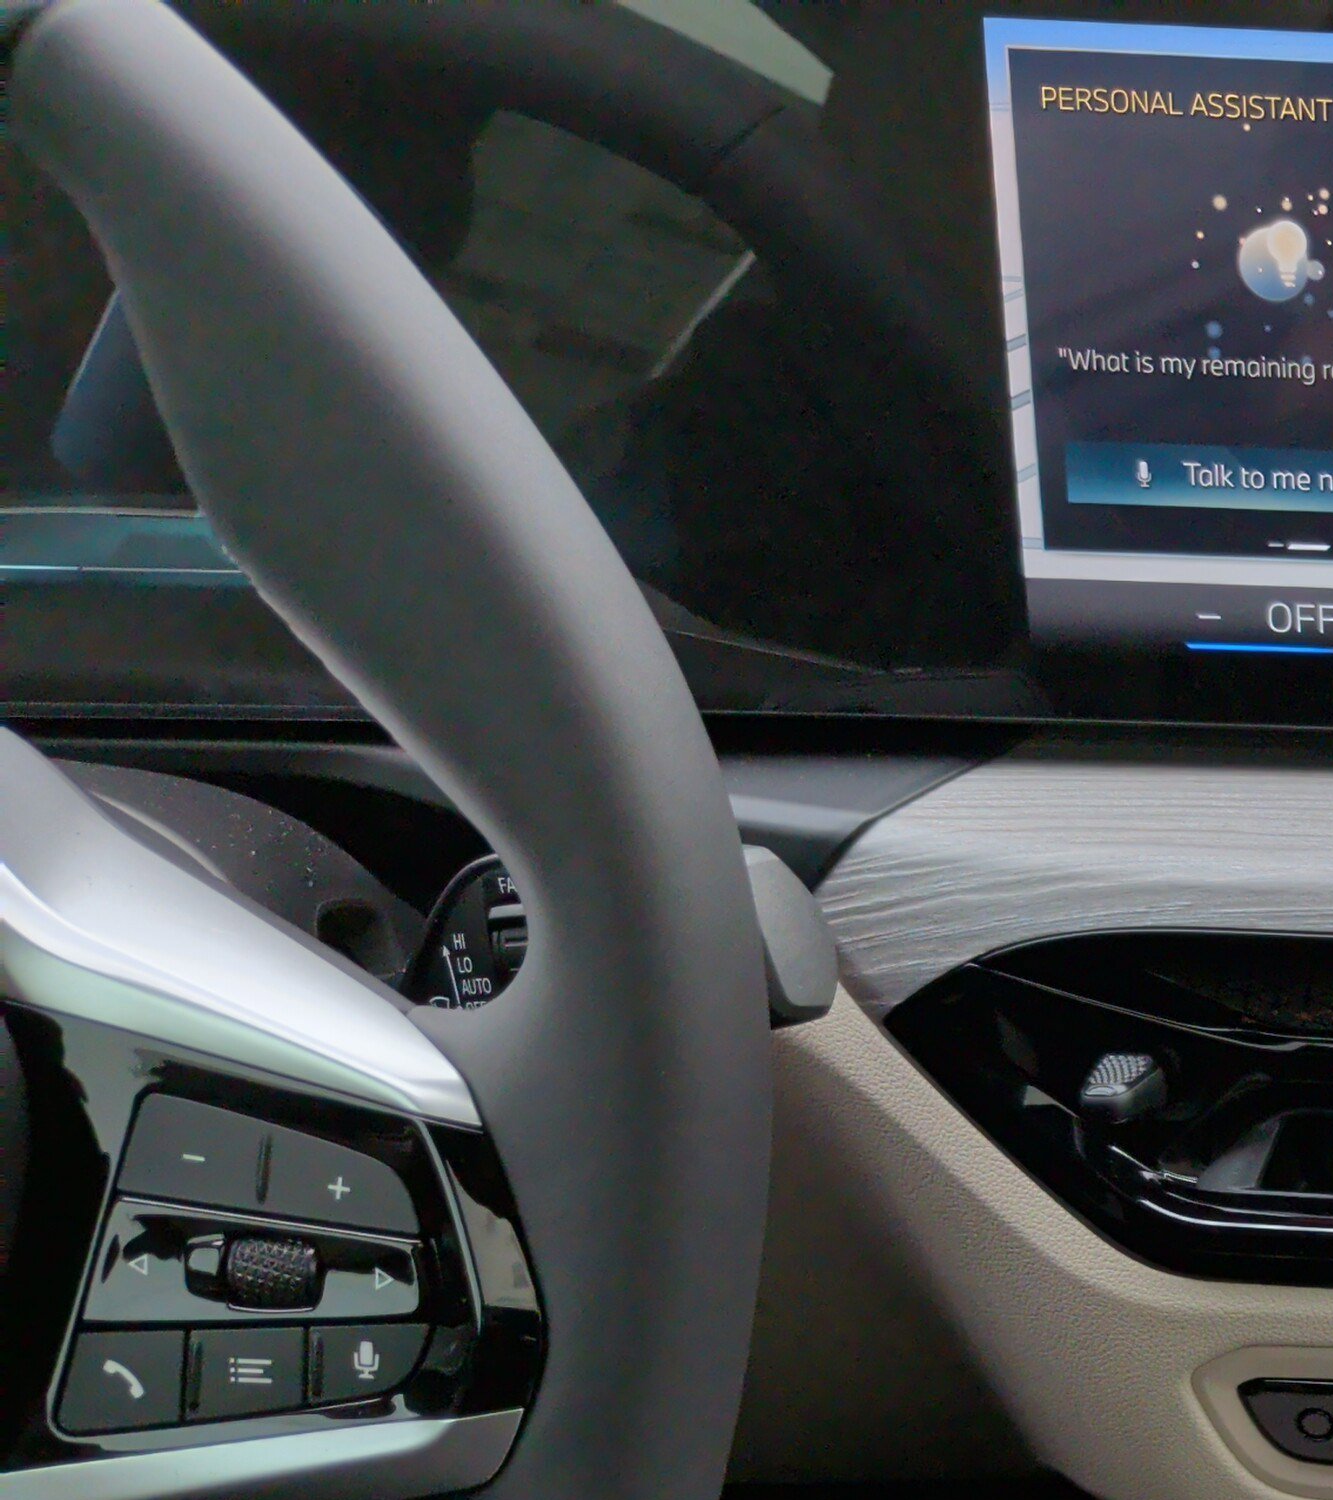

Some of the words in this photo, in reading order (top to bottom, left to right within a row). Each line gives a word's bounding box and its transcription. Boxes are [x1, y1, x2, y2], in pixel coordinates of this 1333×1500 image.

[1041, 86, 1184, 115] PERSONAL
[1190, 93, 1333, 122] ASSISTANT
[1058, 348, 1130, 373] "What
[1135, 350, 1154, 374] is
[1161, 355, 1196, 380] my
[1202, 356, 1316, 387] remaining
[1183, 461, 1235, 489] Talk
[1240, 467, 1266, 490] to
[1272, 471, 1311, 491] me
[453, 933, 467, 951] HI
[457, 957, 473, 973] LO
[462, 978, 492, 995] AUTO
